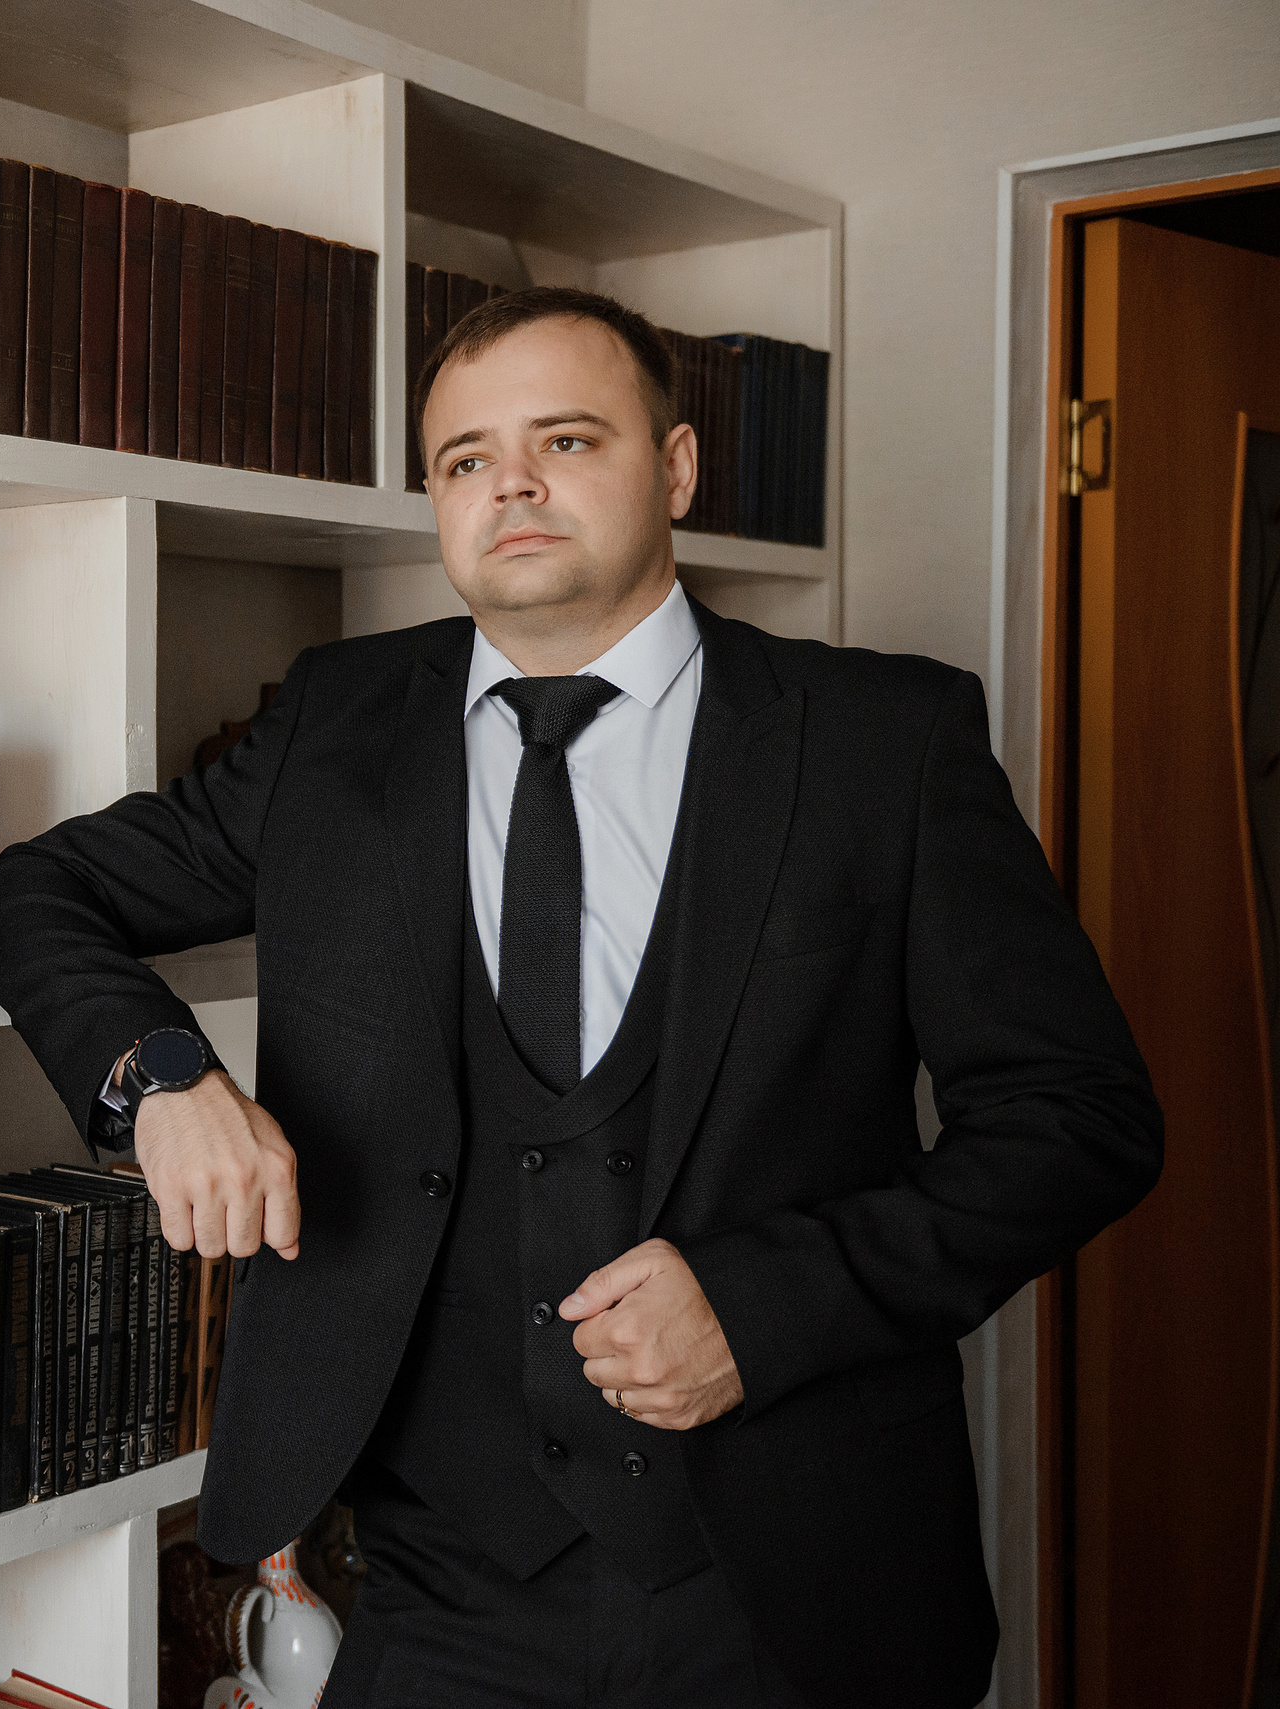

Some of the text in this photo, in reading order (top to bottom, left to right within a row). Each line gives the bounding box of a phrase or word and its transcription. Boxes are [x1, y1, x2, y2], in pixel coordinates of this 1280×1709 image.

[147, 1238, 160, 1329] ПИКУЛЬ
[168, 1250, 180, 1325] ПИКУЛ
[64, 1262, 78, 1448] Валентин ПИКУЛЬ
[85, 1254, 103, 1436] Валентин ПИКУЛЬ
[85, 1449, 95, 1472] 3
[140, 1432, 157, 1455] 10
[43, 1463, 52, 1485] 1
[65, 1460, 76, 1485] 2
